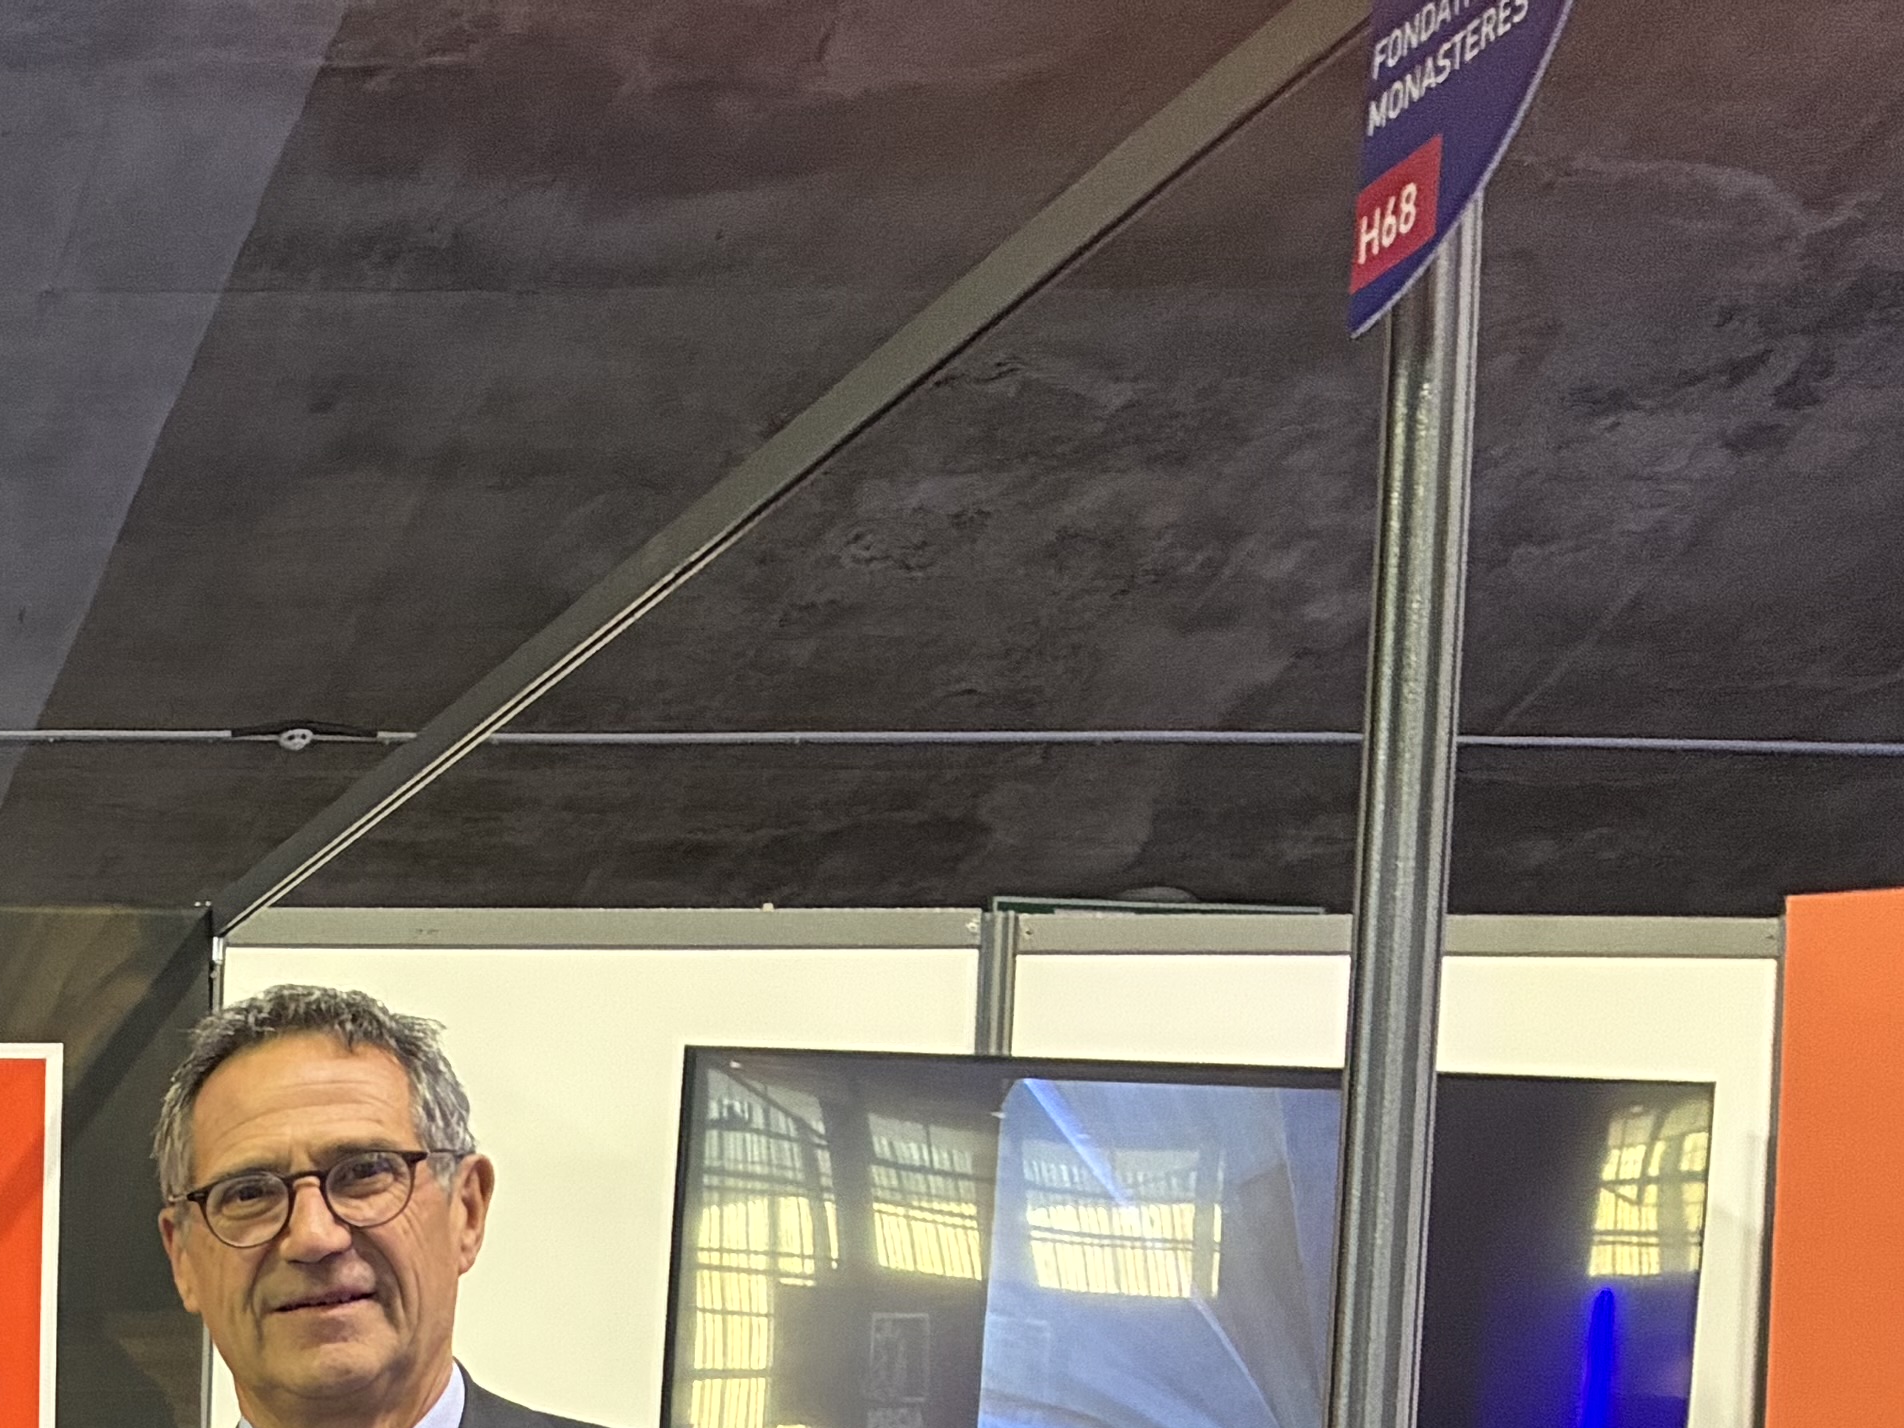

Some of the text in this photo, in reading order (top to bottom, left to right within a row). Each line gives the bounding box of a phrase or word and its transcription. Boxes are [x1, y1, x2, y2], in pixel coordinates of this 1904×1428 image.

[1367, 0, 1529, 136] MONASTERES
[1371, 0, 1470, 80] FONDA
[1357, 182, 1418, 265] H68
